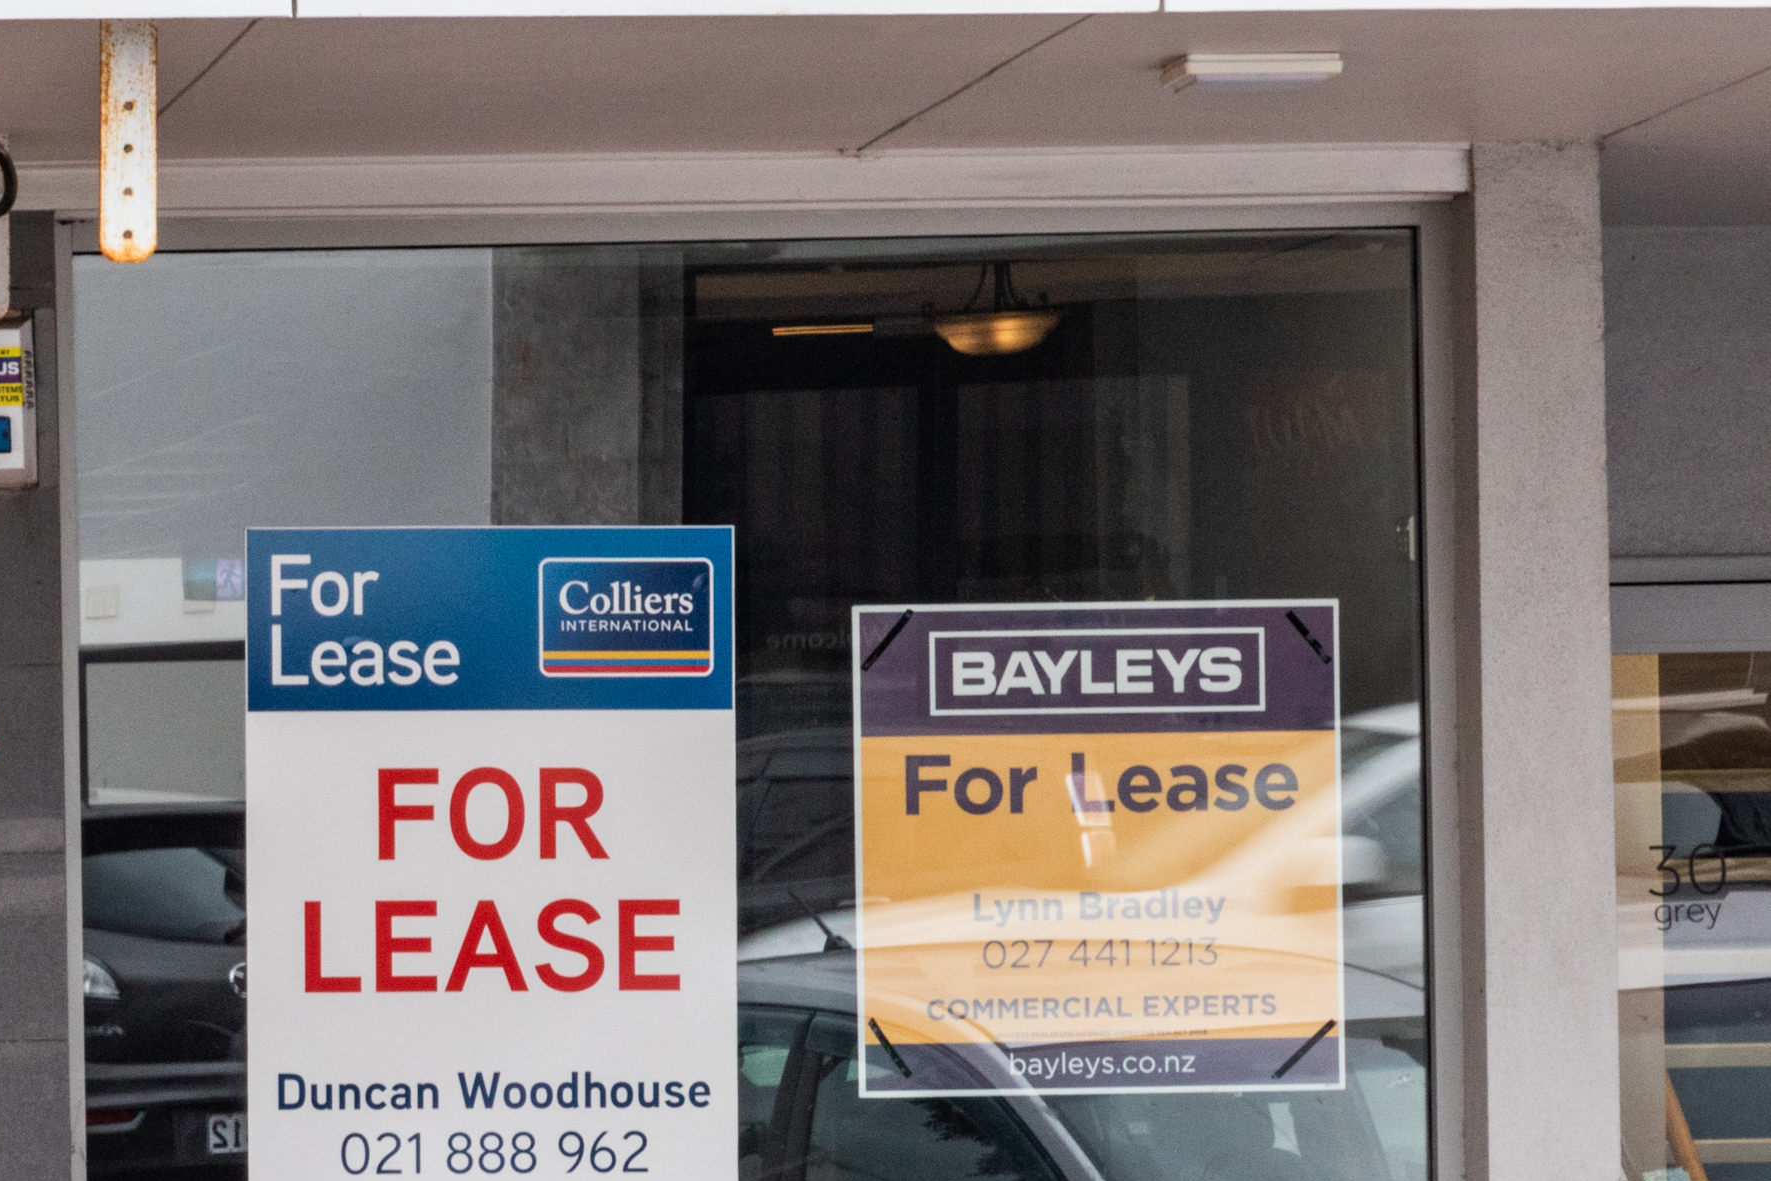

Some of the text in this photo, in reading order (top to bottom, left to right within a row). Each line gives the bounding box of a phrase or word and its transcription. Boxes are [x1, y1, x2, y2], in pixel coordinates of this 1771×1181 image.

[270, 554, 378, 617] For
[558, 579, 695, 617] Colliers
[560, 619, 694, 633] INTERNATIONAL
[271, 623, 460, 687] Lease
[952, 646, 1242, 696] BAYLEYS
[905, 752, 1299, 815] For Lease
[377, 766, 610, 862] FOR
[1649, 843, 1726, 897] 30
[973, 889, 1226, 927] Lynn Bradley
[1654, 903, 1721, 931] grey
[304, 898, 681, 993] LEASE
[983, 936, 1218, 969] 027 441 1213
[927, 993, 1277, 1021] COMMERCIAL EXPERTS
[1009, 1052, 1195, 1080] bayleys.co.nz
[277, 1070, 712, 1112] Duncan Woodhouse
[340, 1130, 649, 1175] 021 888 962
